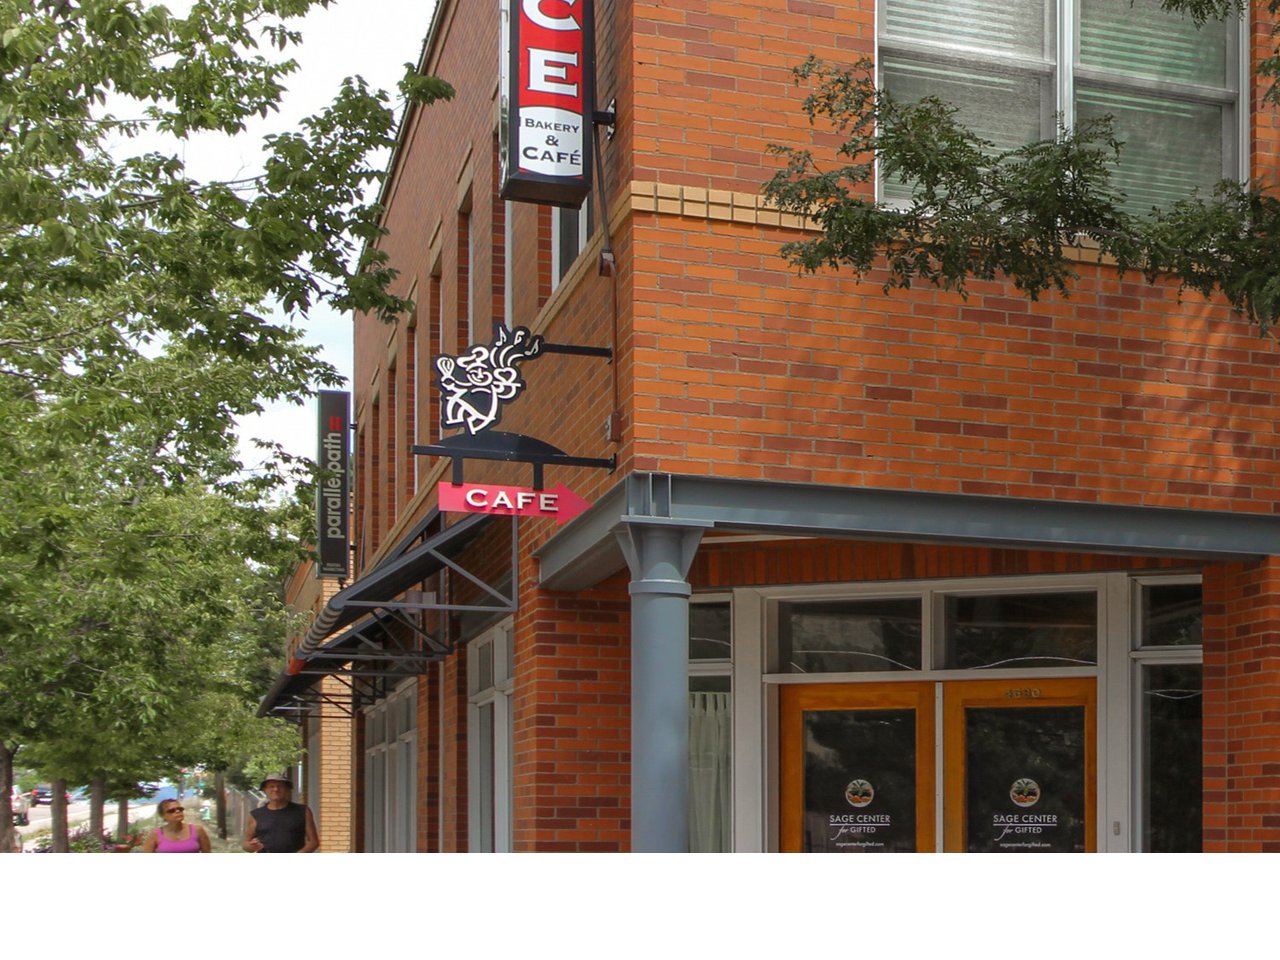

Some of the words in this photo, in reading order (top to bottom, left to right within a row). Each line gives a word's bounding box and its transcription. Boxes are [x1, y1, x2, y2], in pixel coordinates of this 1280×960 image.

[525, 118, 580, 134] BAKERY
[545, 135, 559, 147] &
[522, 146, 581, 166] CAFÉ
[323, 432, 345, 538] parallepath
[465, 489, 559, 512] CAFE
[829, 814, 854, 823] SAGE
[856, 814, 891, 823] CENTER
[993, 814, 1019, 823] SAGE
[1021, 814, 1058, 823] CENTER
[850, 826, 876, 834] GIFTED
[1015, 826, 1043, 834] GIFTED
